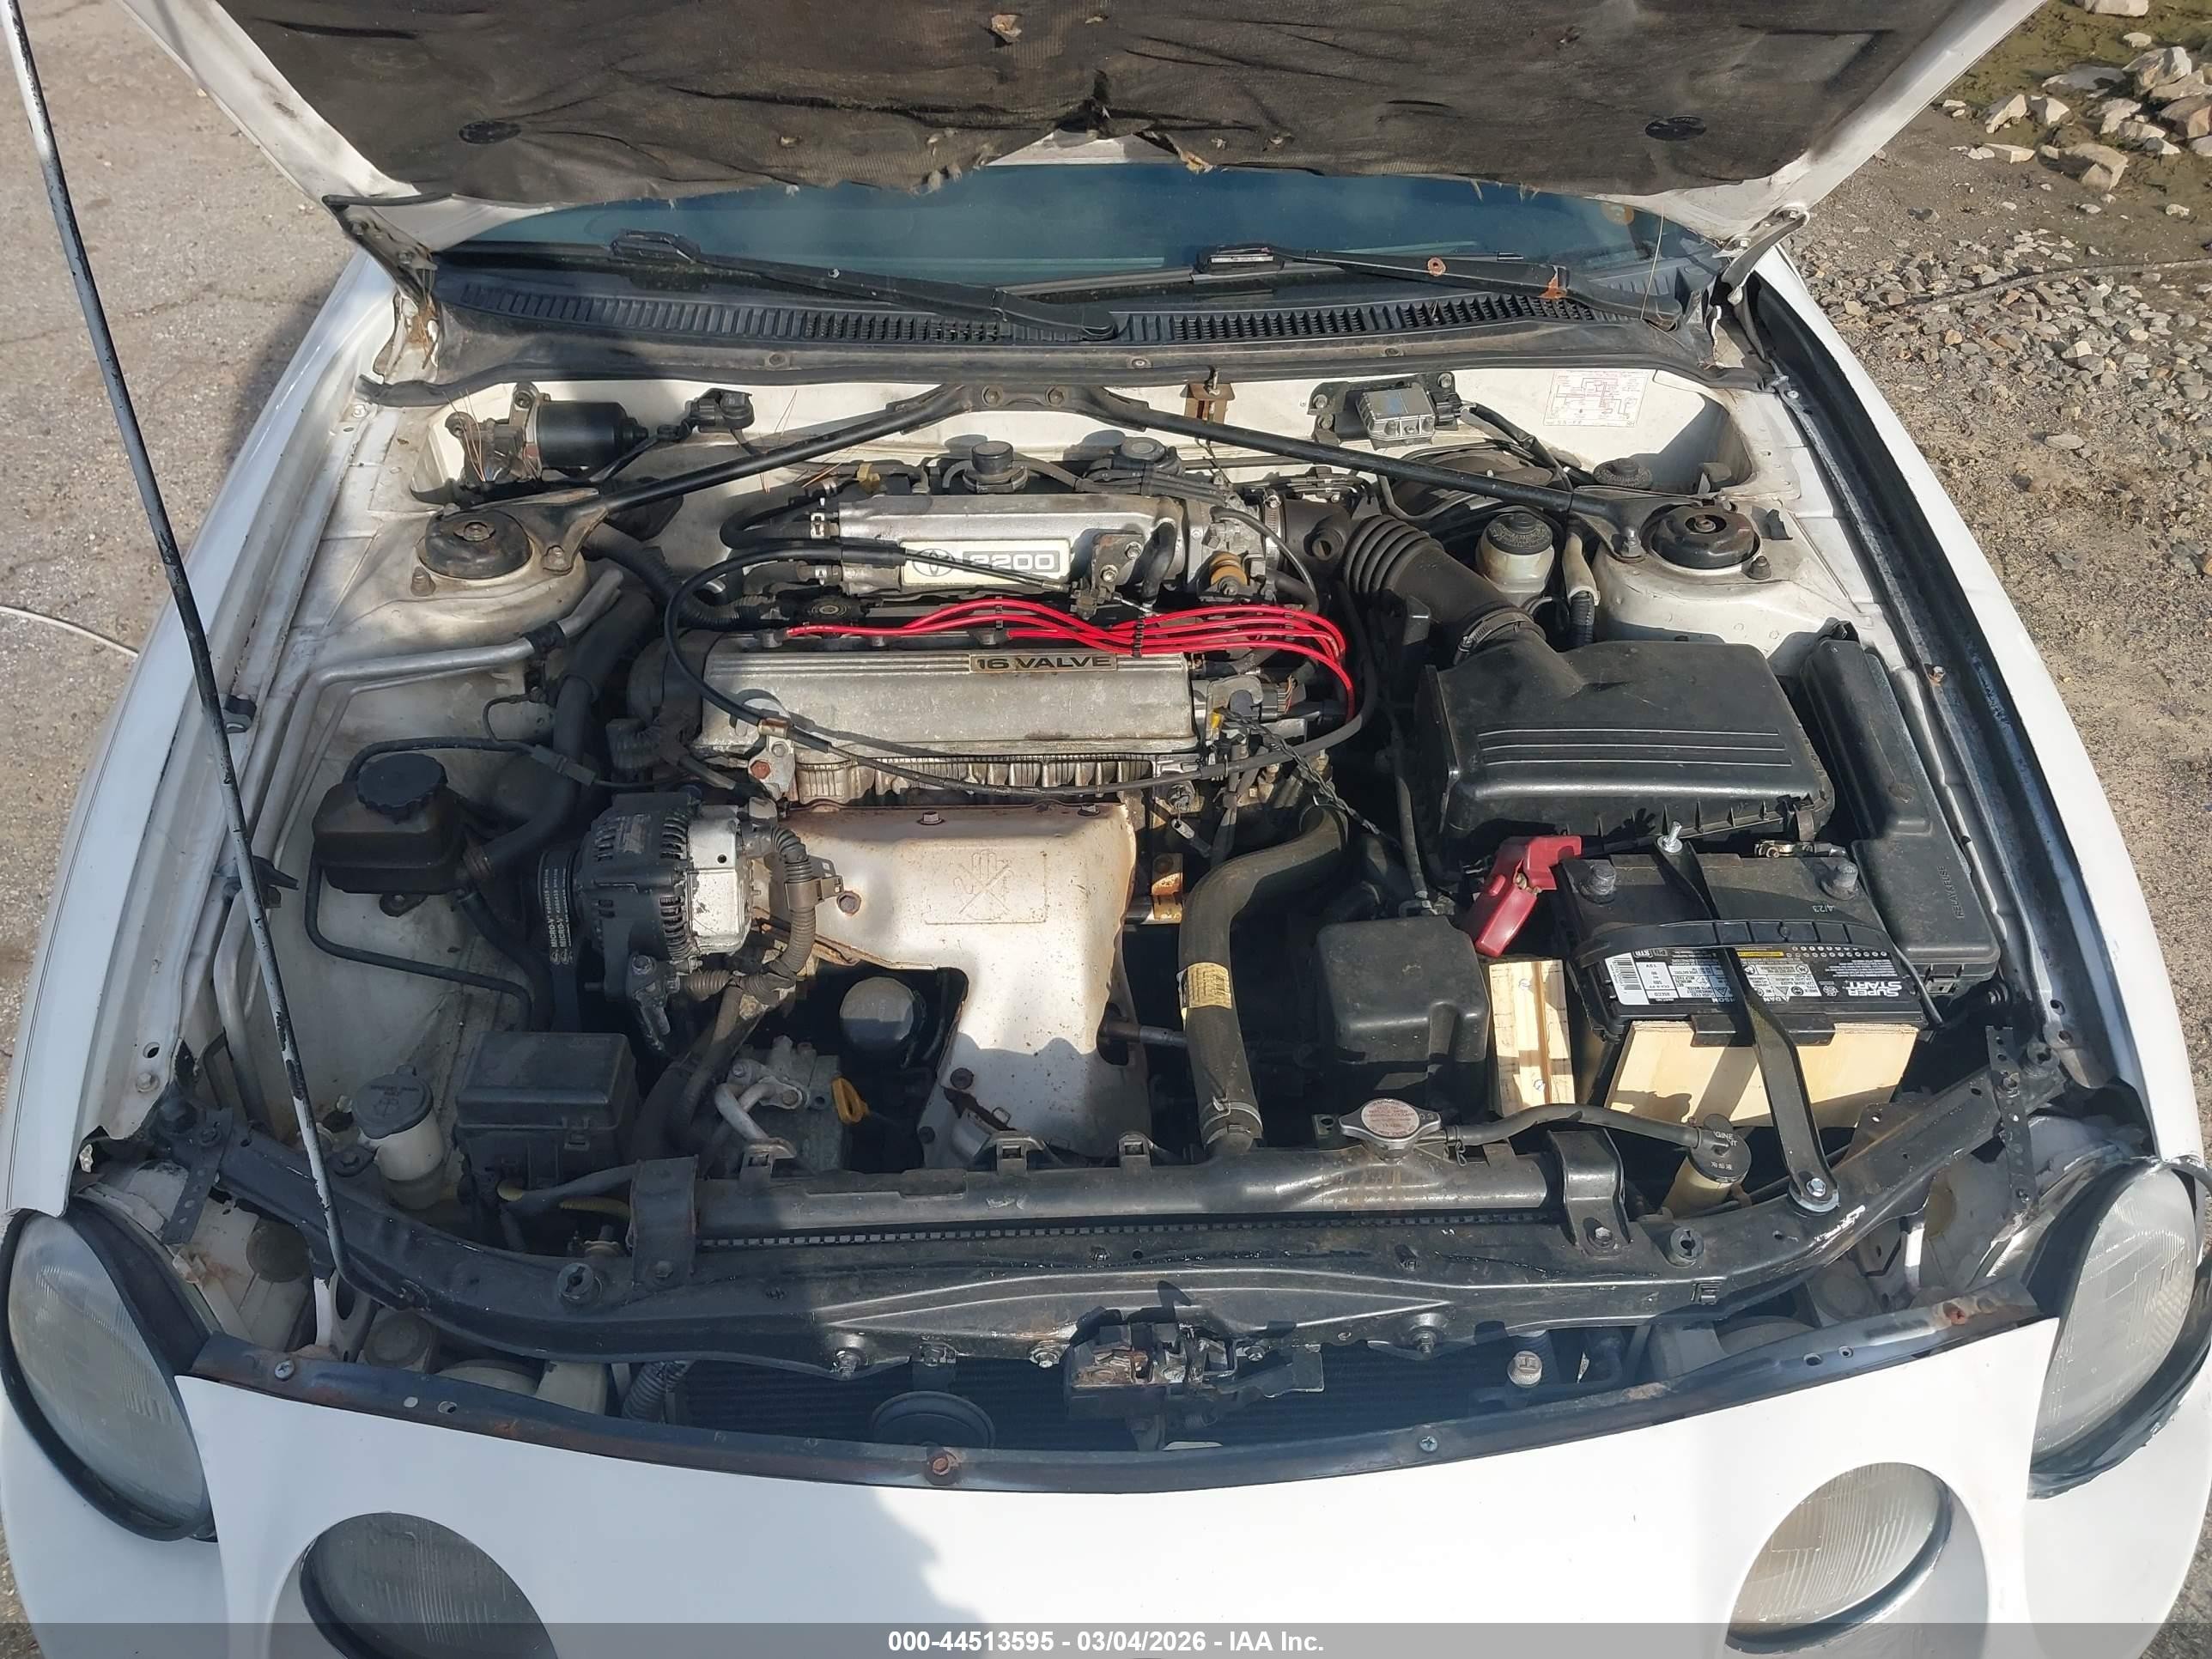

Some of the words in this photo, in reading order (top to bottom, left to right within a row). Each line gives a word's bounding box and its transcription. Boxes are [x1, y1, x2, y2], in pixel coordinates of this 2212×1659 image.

[976, 658, 1010, 670] 16
[1015, 656, 1112, 669] VALVE
[1845, 981, 1903, 990] START
[1847, 988, 1899, 997] SUPER
